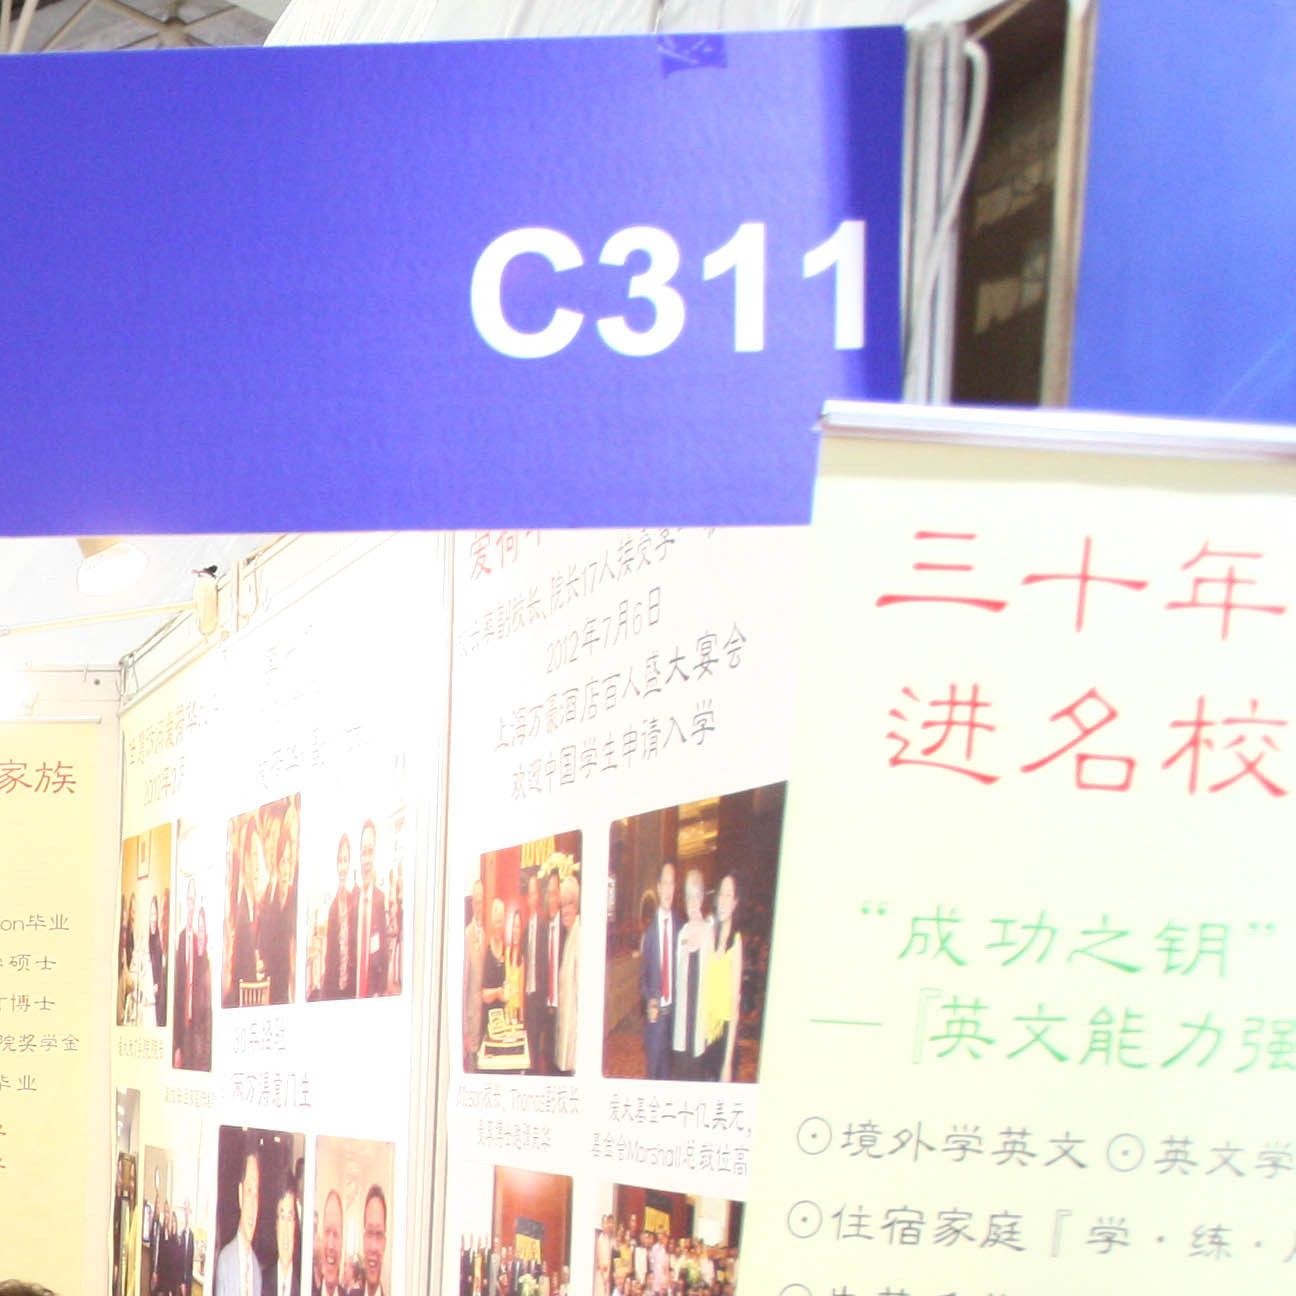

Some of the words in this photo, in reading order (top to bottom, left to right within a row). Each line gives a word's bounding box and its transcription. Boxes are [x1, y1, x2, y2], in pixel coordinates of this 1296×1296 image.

[468, 218, 866, 359] C311
[874, 529, 1288, 641] 三十年
[884, 682, 1290, 799] 进名校
[839, 1119, 1090, 1171] 境外学英文
